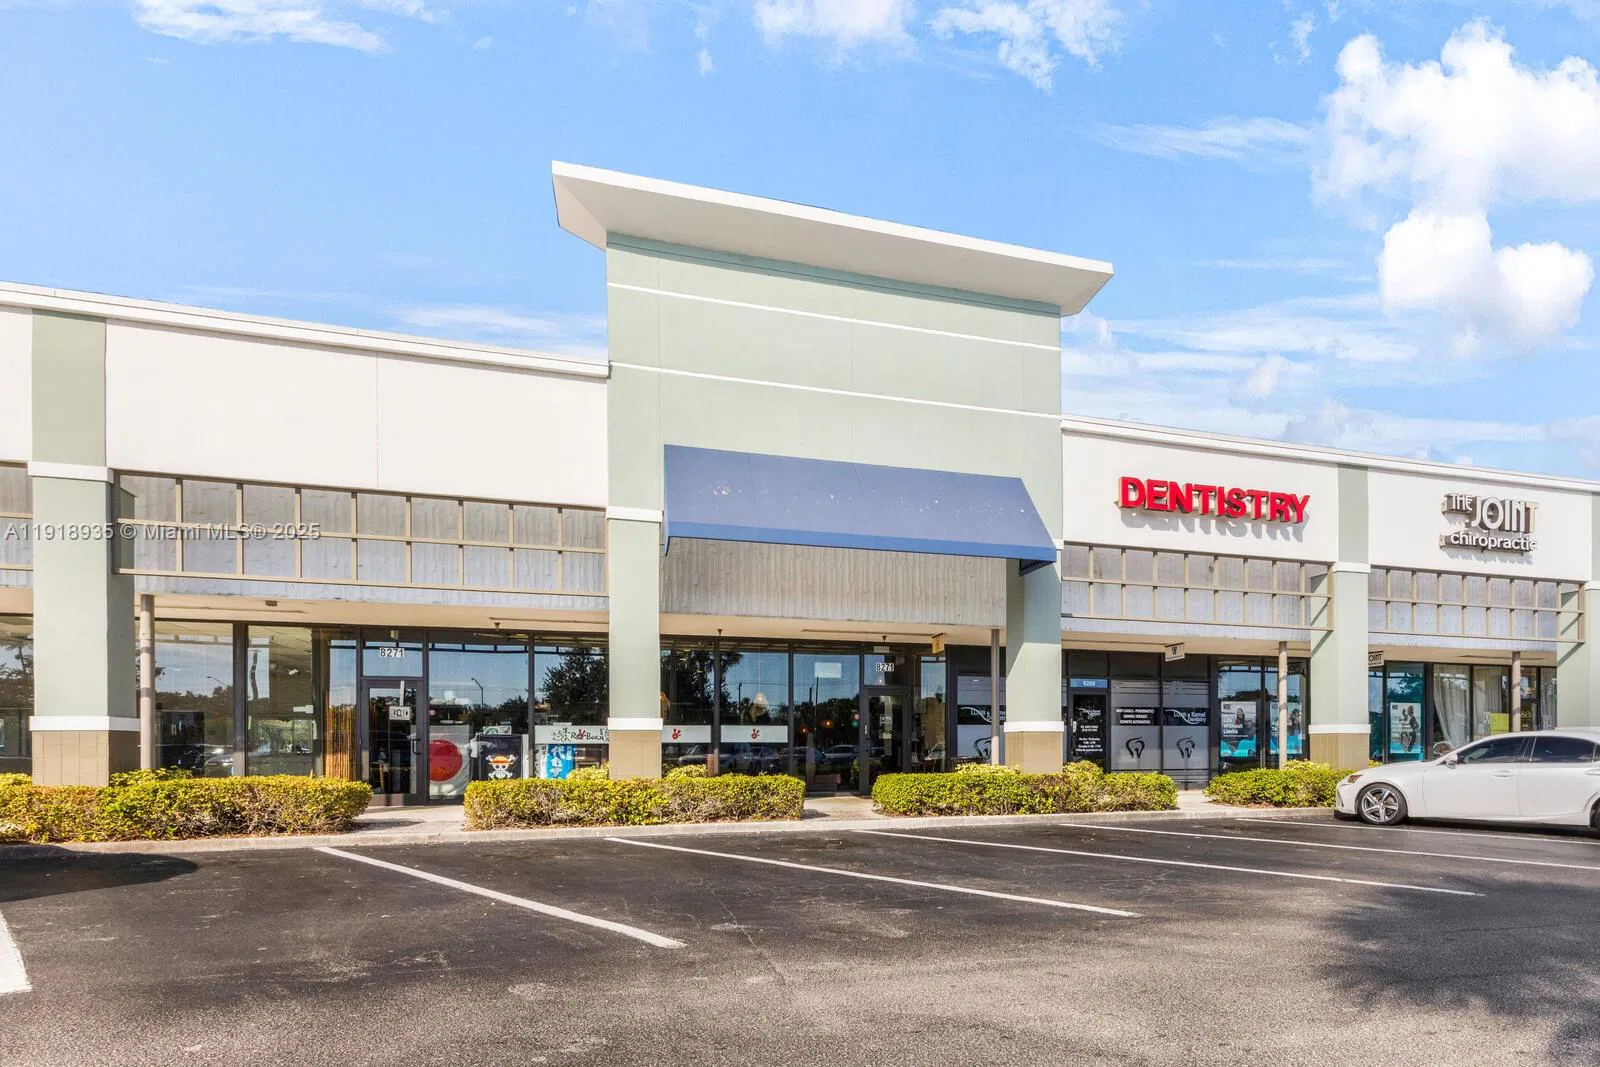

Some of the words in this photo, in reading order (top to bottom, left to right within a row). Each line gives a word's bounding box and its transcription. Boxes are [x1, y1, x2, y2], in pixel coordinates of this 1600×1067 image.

[1119, 476, 1311, 524] DENTISTRY
[1449, 494, 1473, 511] THE
[1471, 496, 1539, 533] JOINT
[1451, 532, 1537, 551] chiropractic
[380, 648, 405, 657] 8271
[1368, 654, 1382, 662] OINT
[876, 663, 894, 671] 8271
